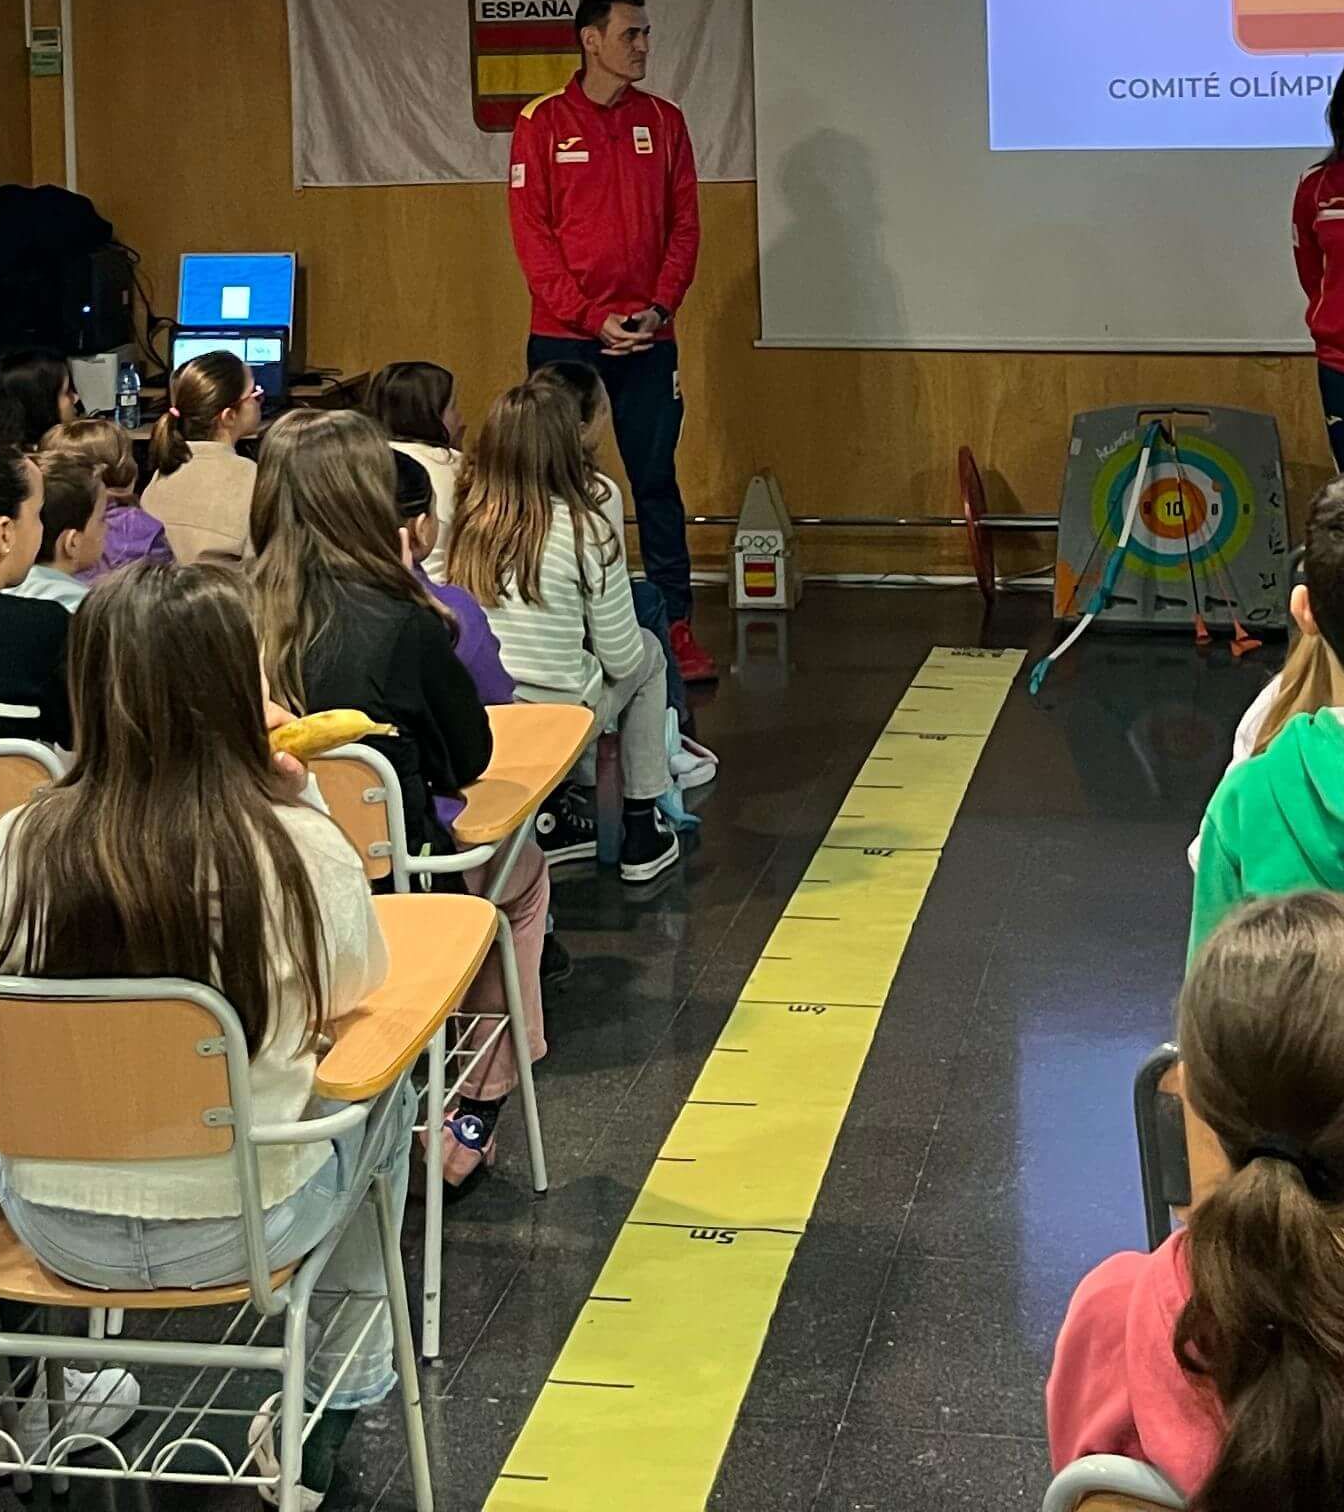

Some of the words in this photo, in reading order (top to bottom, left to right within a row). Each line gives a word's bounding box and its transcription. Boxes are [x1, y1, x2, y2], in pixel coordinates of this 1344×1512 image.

[1107, 70, 1222, 100] COMITÉ
[1164, 501, 1183, 517] 10
[788, 1004, 827, 1016] 6m
[689, 1228, 738, 1245] 5m
